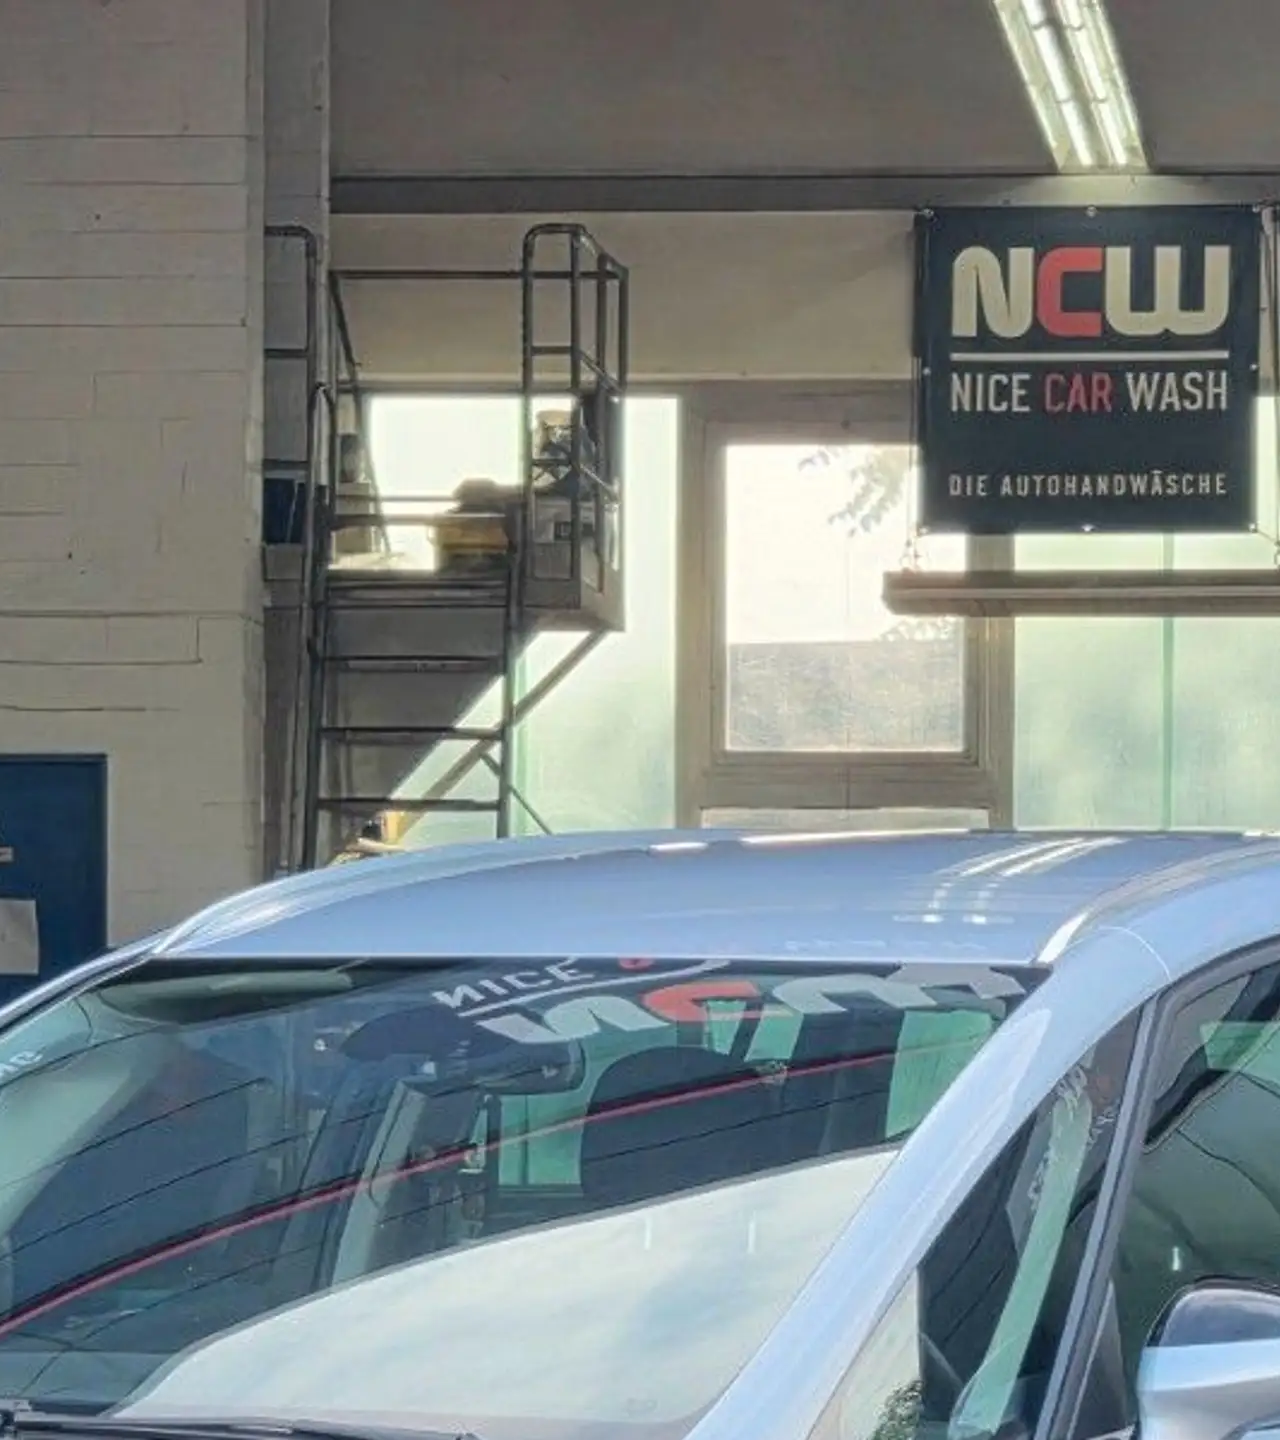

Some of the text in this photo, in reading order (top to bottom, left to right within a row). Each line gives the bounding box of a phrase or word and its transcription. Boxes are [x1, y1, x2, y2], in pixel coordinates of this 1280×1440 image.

[951, 245, 1232, 338] NCW
[951, 371, 1228, 413] NICE CAR WASH
[949, 469, 1228, 496] DIE AUTOHANDWÄSCHE
